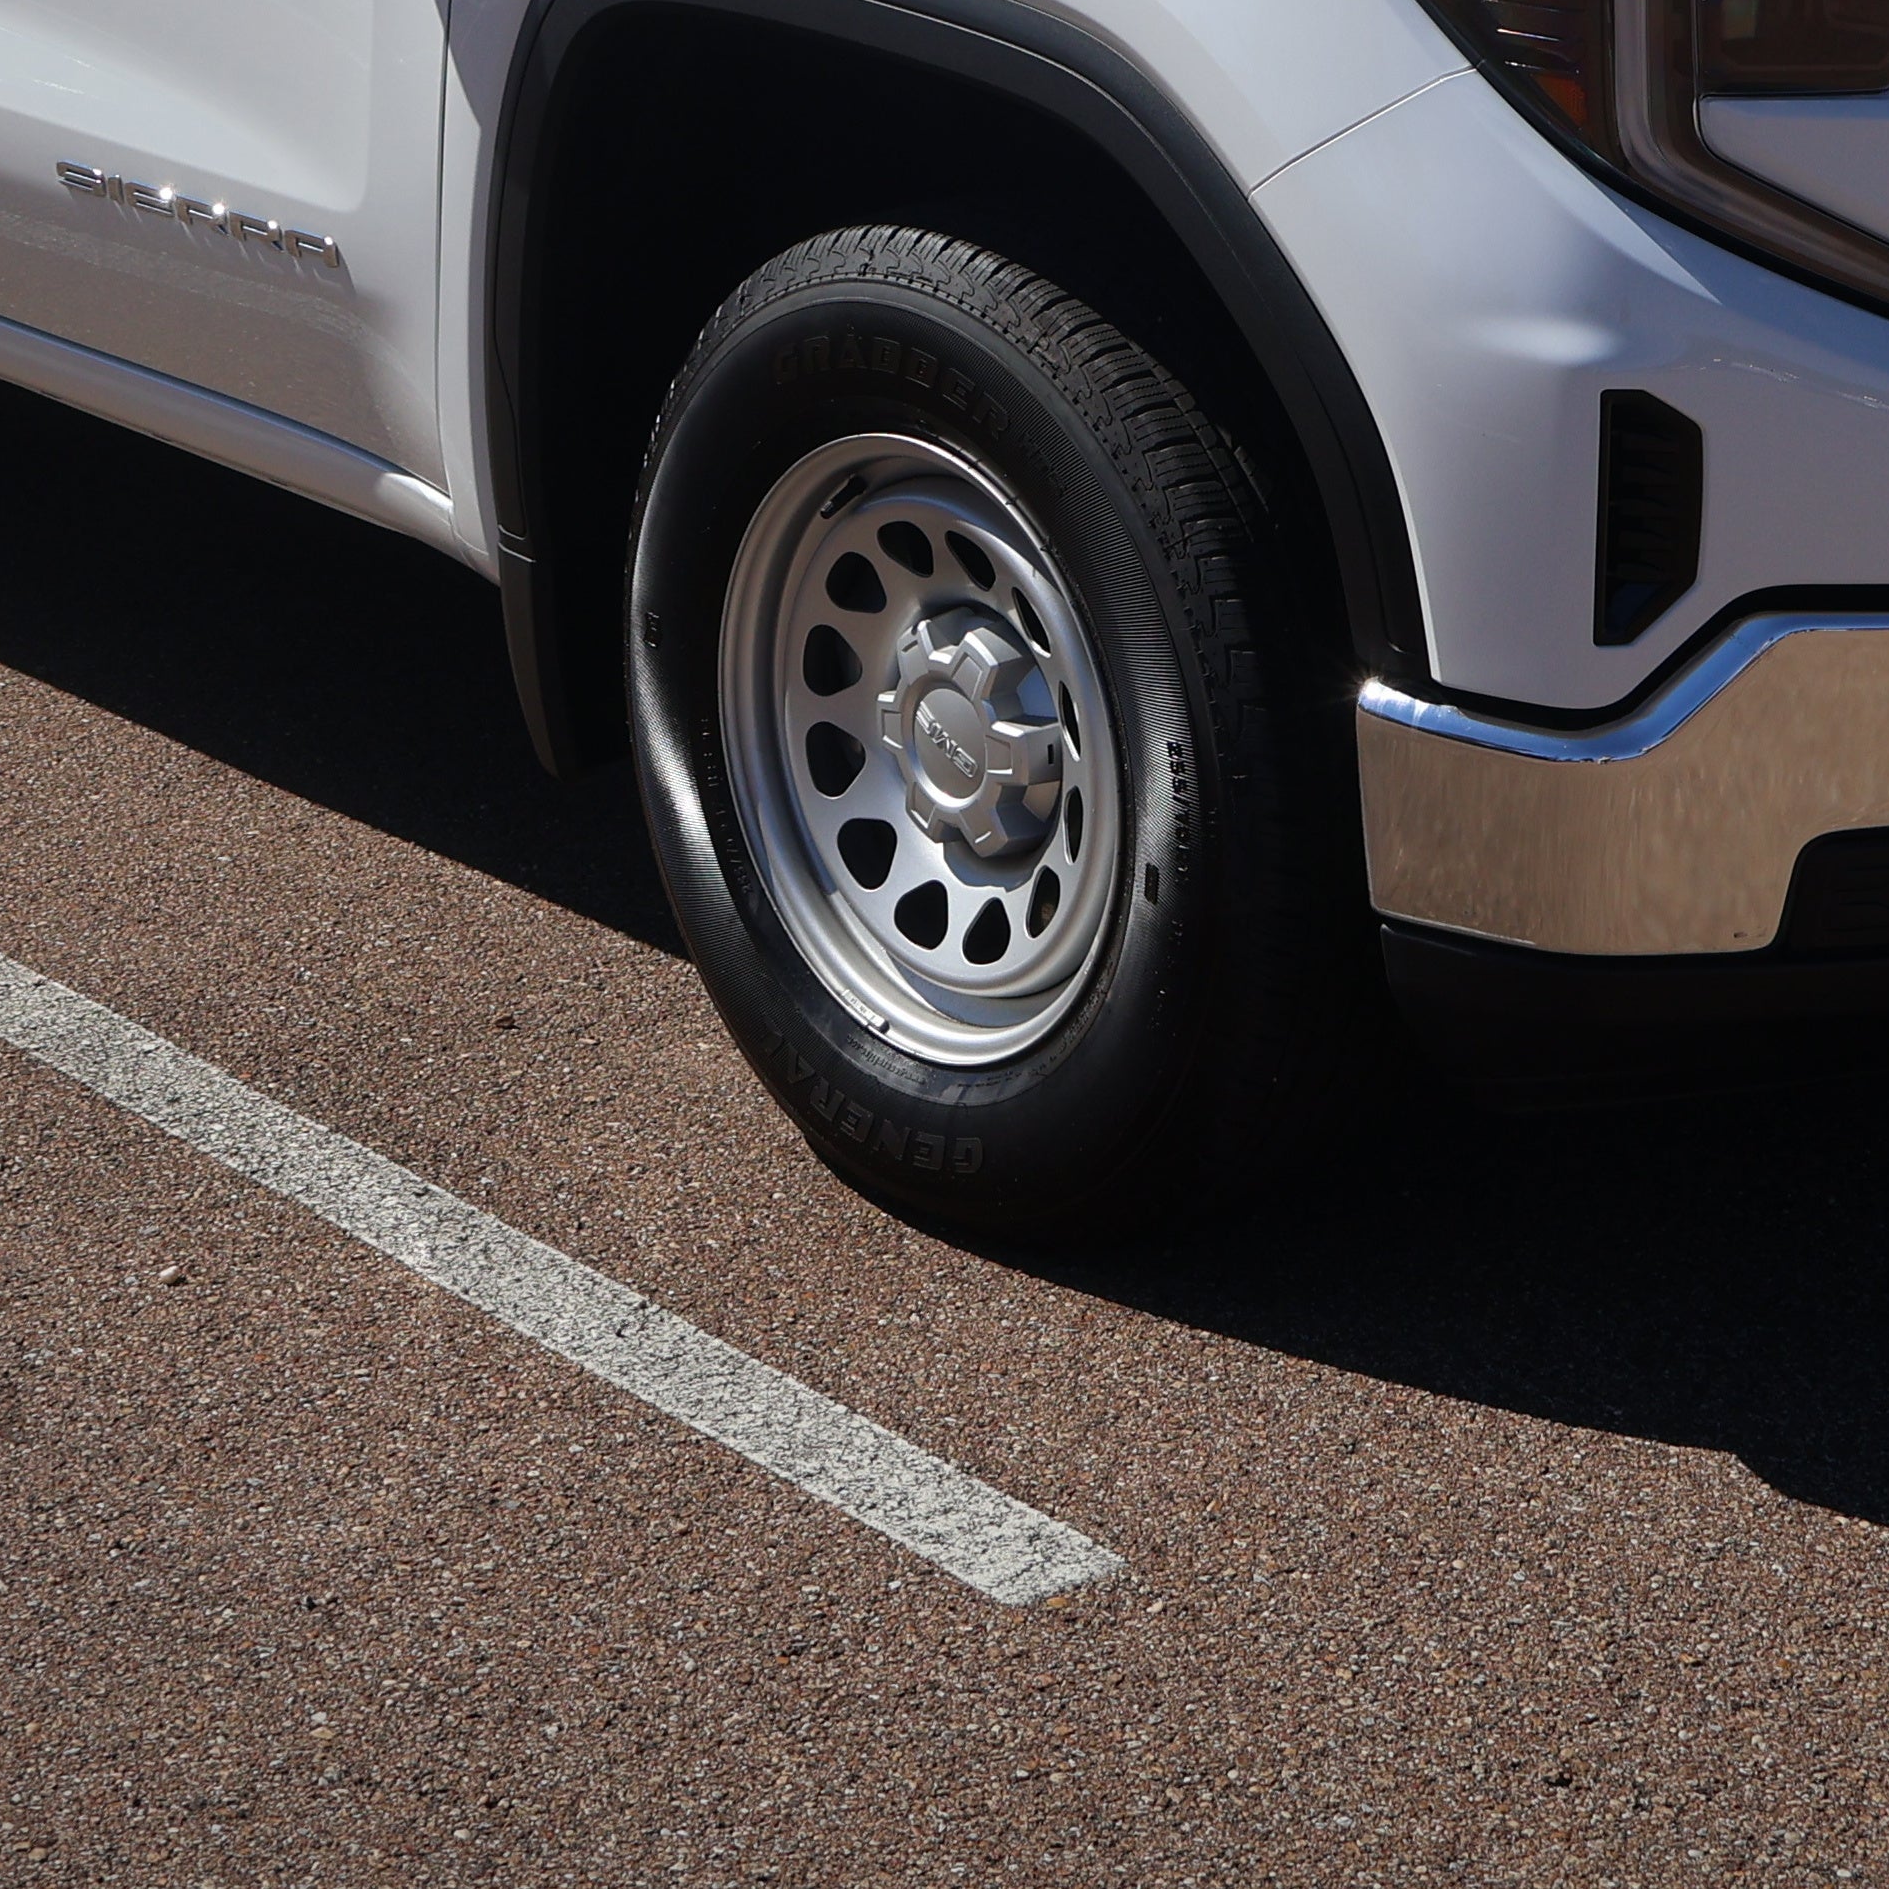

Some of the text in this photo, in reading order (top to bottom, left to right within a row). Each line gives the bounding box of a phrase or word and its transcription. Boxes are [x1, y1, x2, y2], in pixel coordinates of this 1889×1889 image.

[773, 332, 1010, 441] GRABBER
[915, 700, 979, 779] GMC
[758, 1020, 985, 1175] GENERAL
